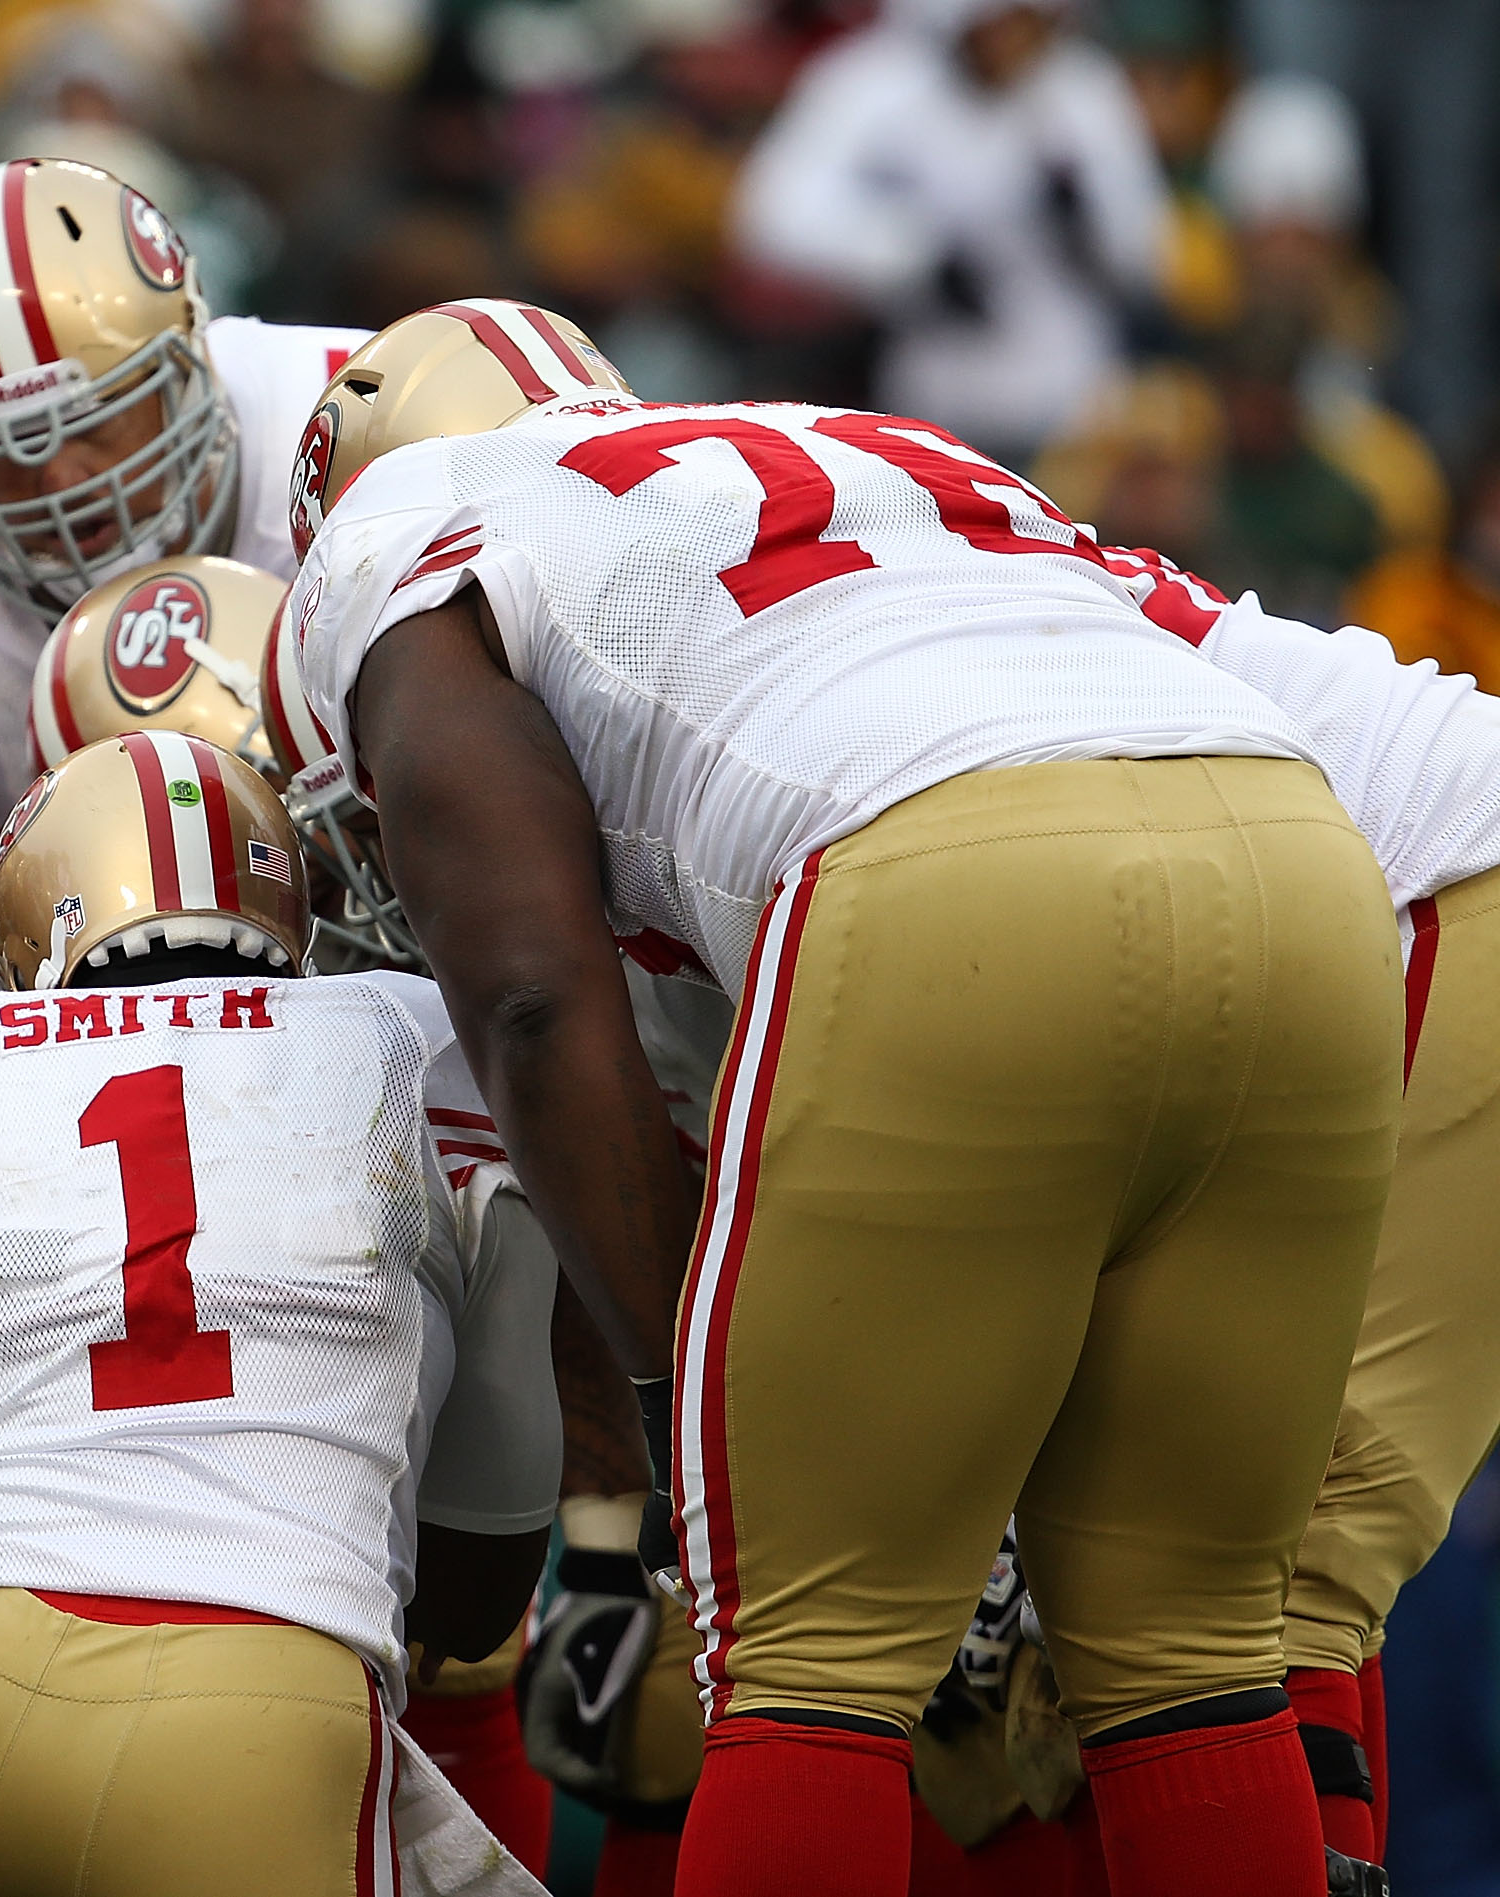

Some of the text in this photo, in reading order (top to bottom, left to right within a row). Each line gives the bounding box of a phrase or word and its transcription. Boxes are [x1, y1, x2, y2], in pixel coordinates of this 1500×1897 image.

[557, 413, 1109, 619] 76
[0, 987, 274, 1049] SMITH
[78, 1064, 234, 1411] 1
